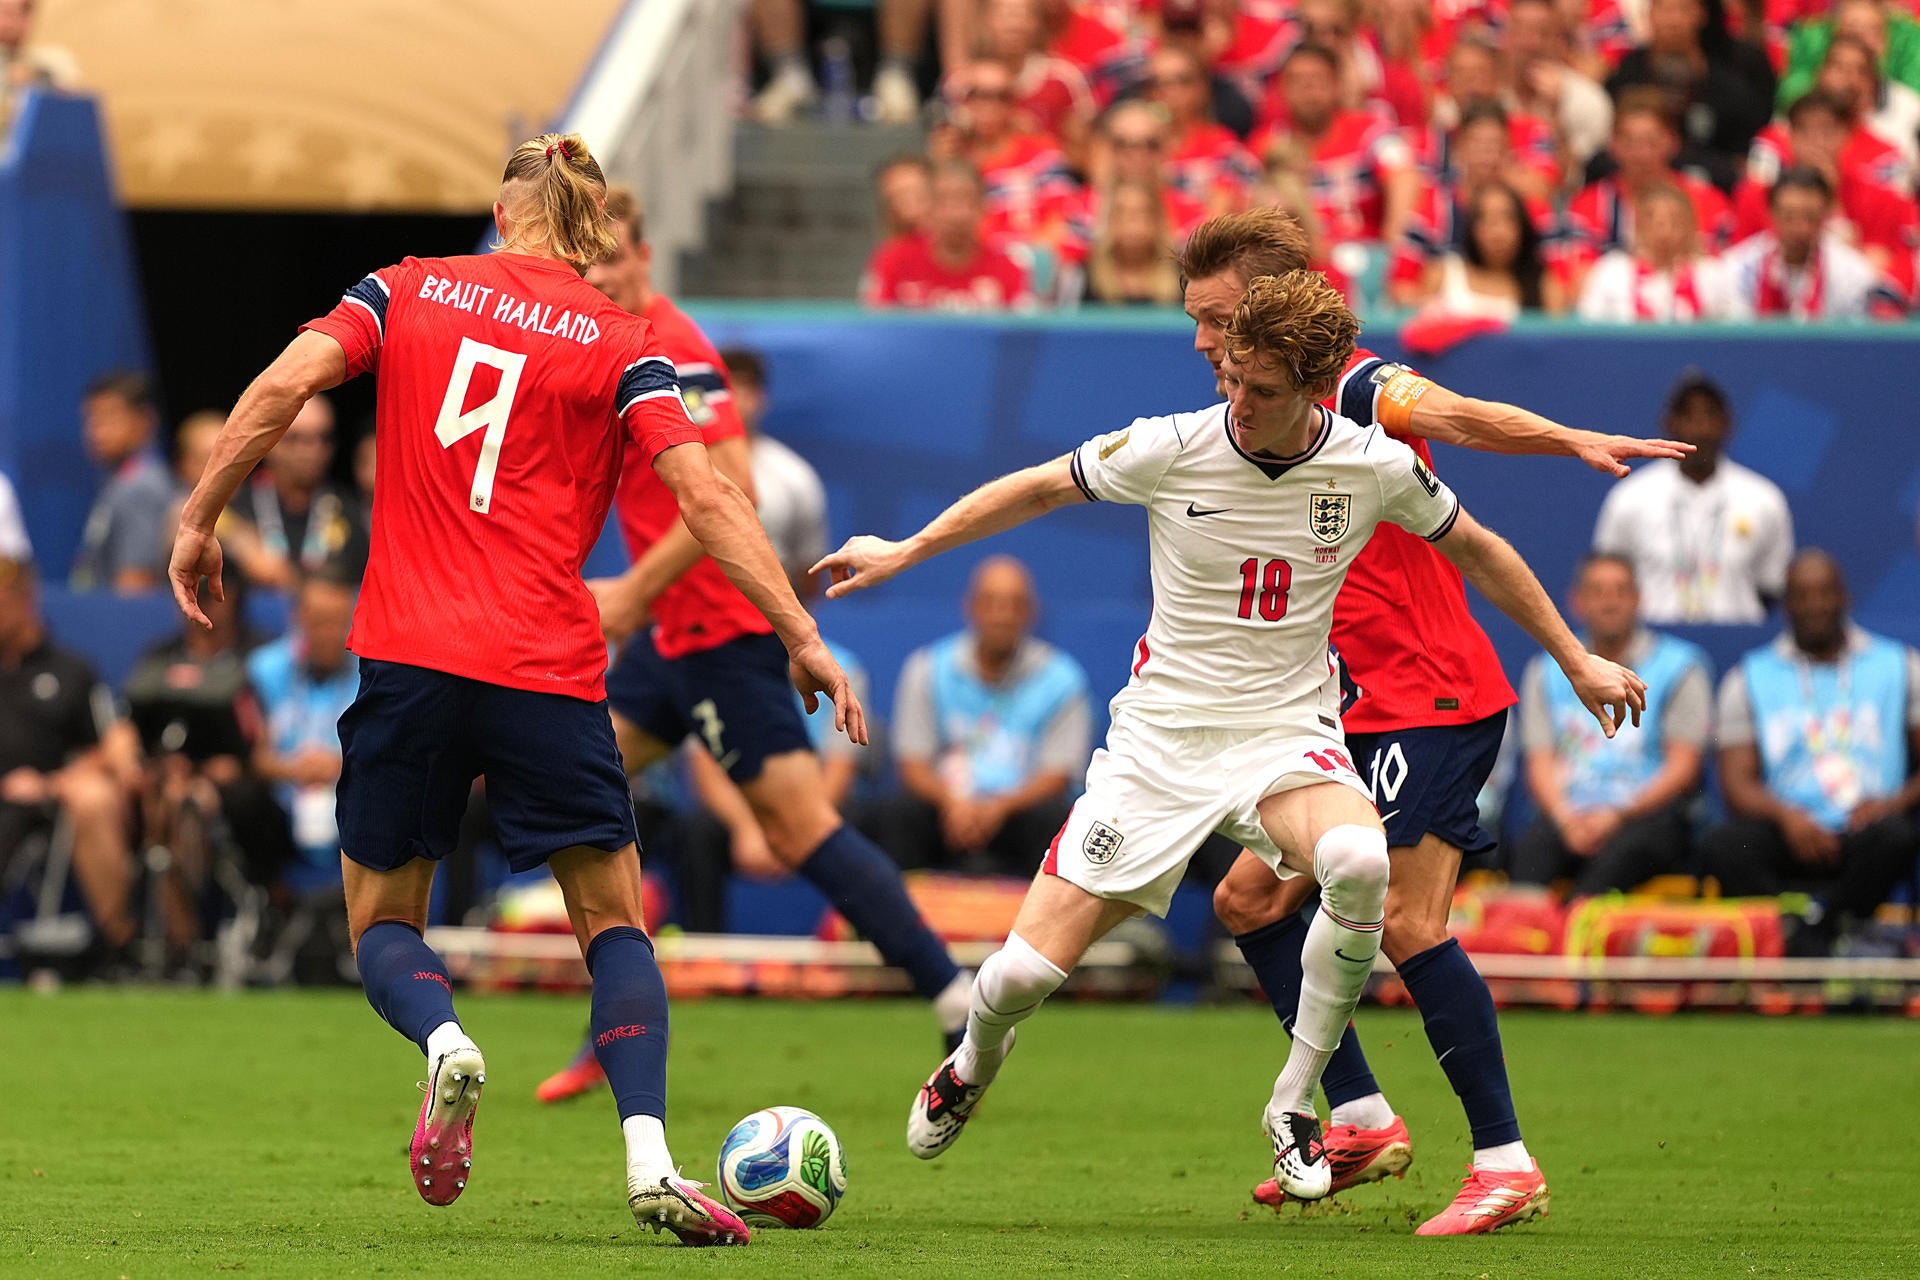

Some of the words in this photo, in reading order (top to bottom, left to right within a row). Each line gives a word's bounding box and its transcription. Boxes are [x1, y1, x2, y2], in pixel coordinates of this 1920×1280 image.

[418, 274, 493, 315] BRAUT
[493, 293, 600, 345] HAALAND
[433, 335, 528, 515] 9
[1314, 544, 1340, 554] NORWAY
[1237, 557, 1292, 622] 18
[1370, 742, 1409, 807] 10
